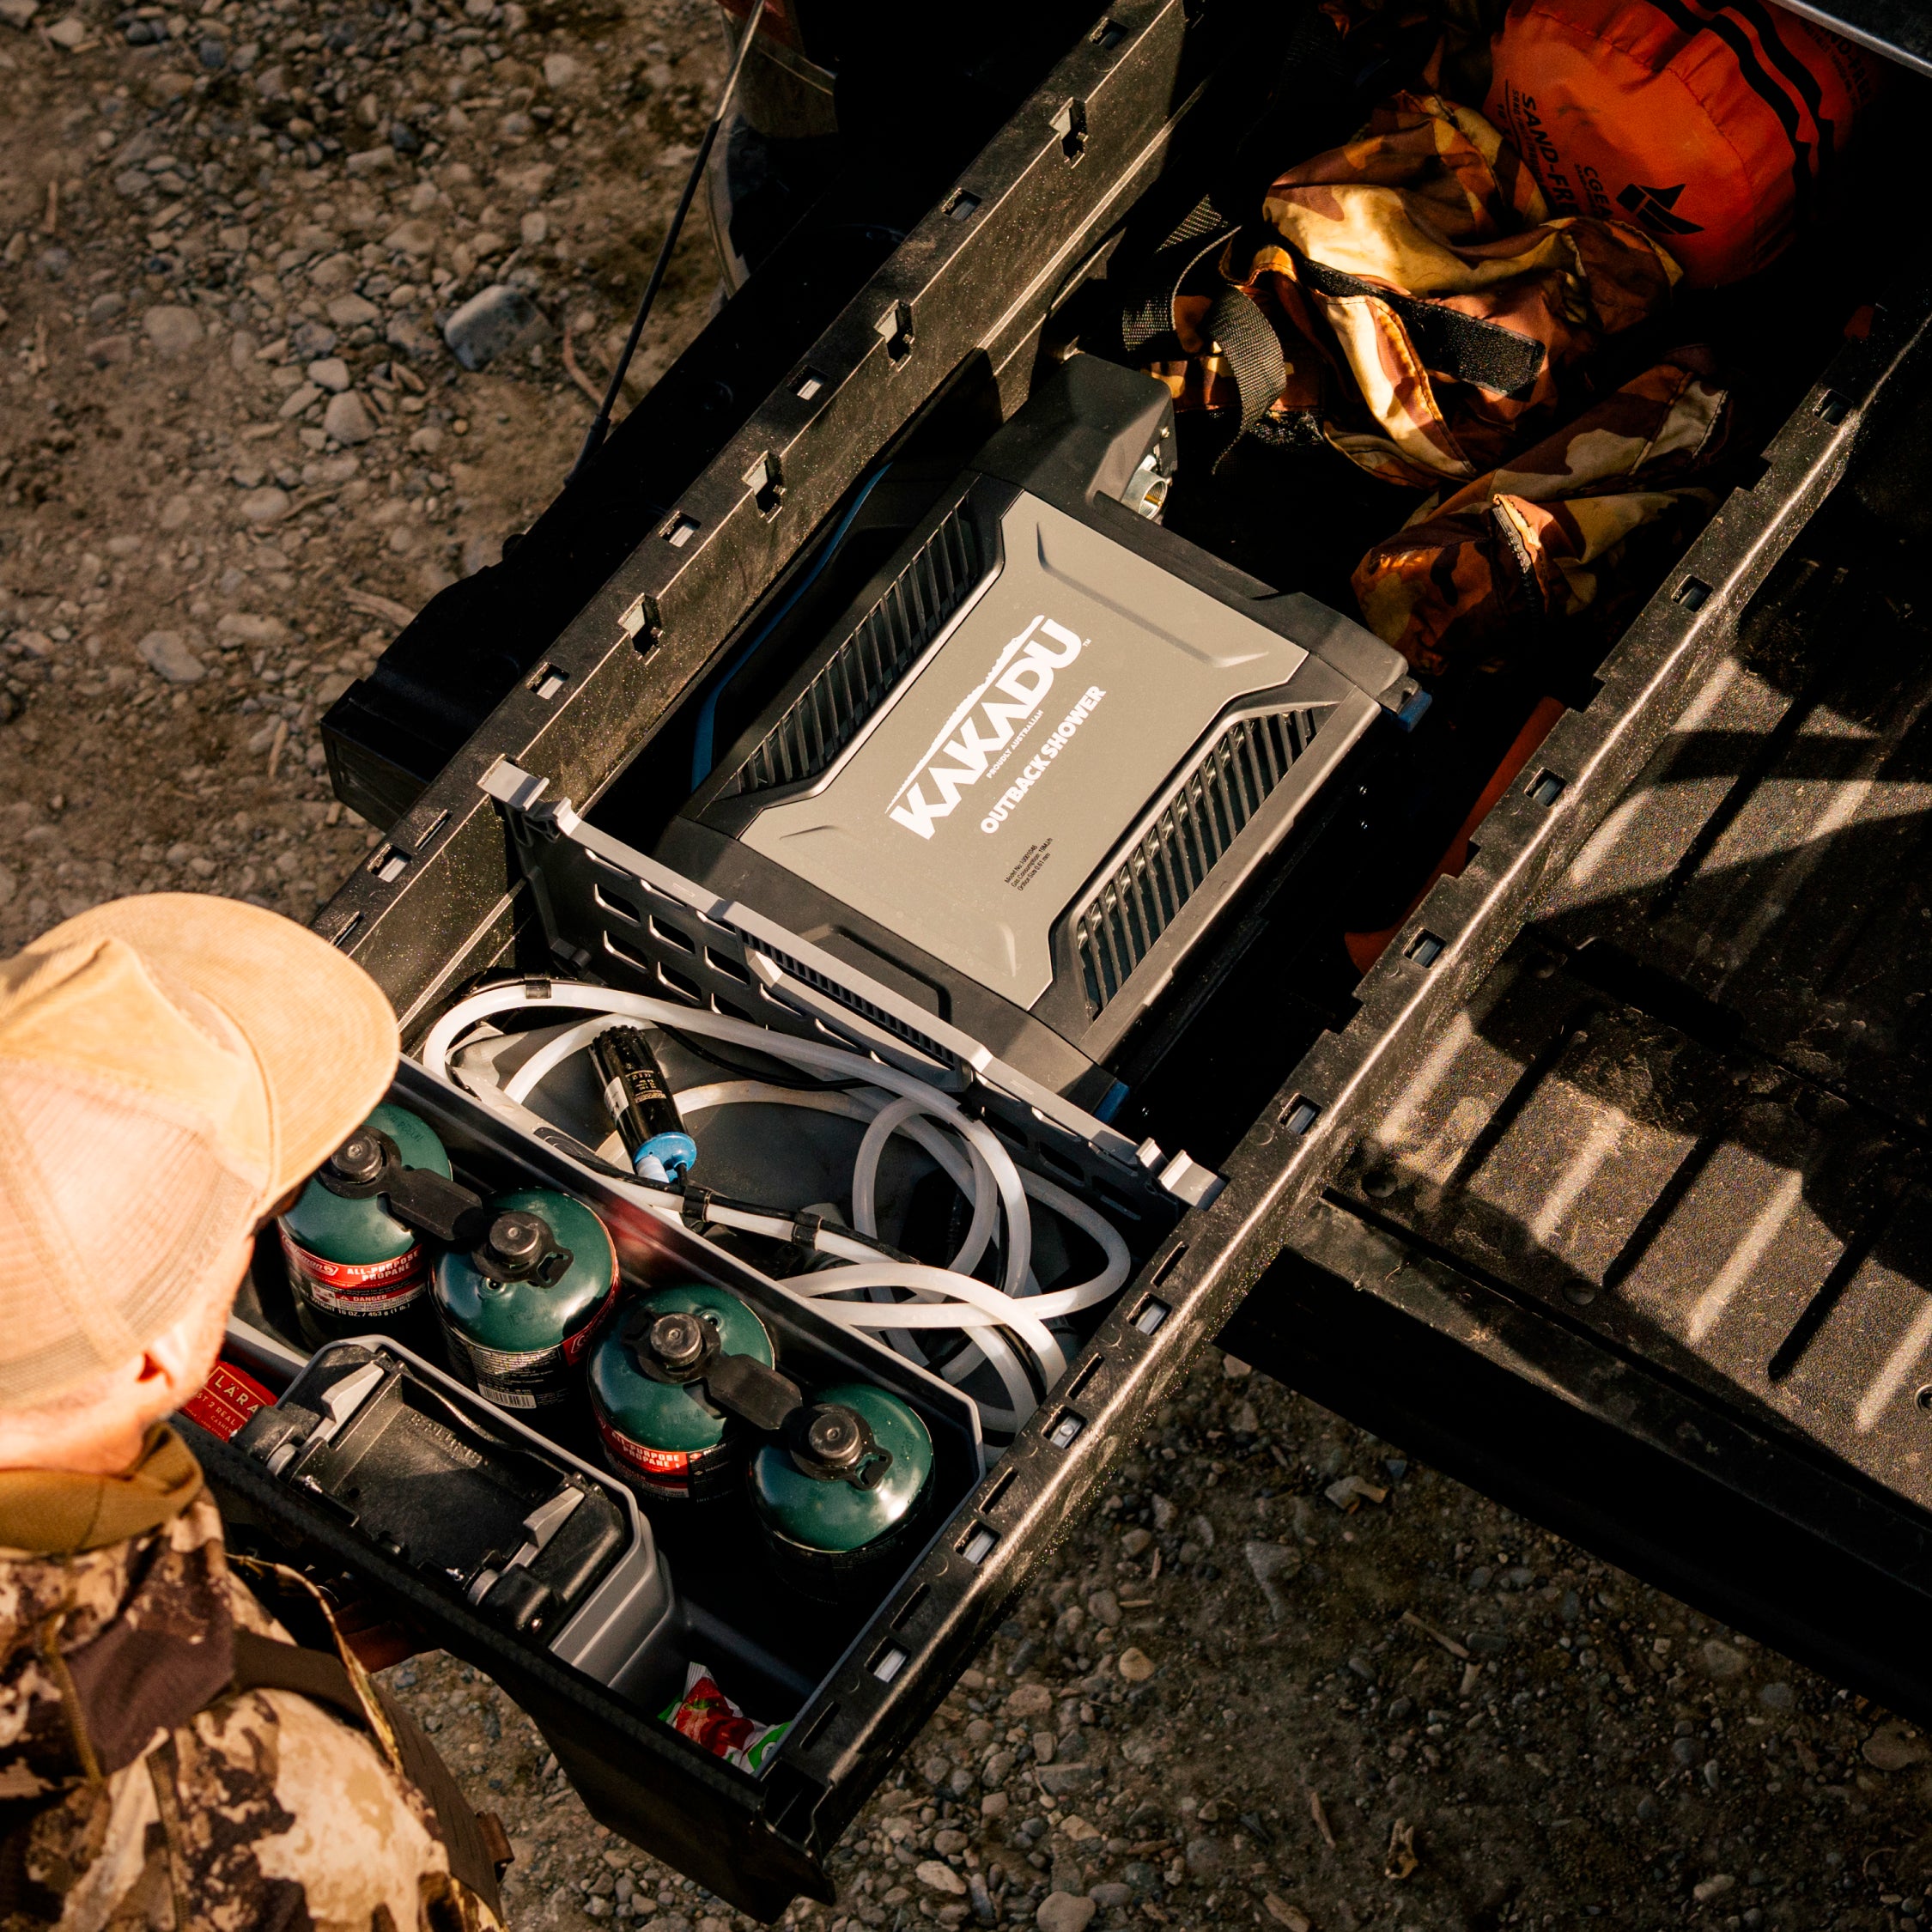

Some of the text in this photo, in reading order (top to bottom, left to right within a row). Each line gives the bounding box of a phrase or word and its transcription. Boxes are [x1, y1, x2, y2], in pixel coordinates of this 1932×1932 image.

[889, 617, 1083, 841] KAKADU
[986, 709, 1044, 780] PROUDLY AUSTRALIAN
[981, 685, 1107, 834] OUTBACK SHOWER
[347, 1249, 419, 1277] ALL-PURPOSE
[361, 1261, 411, 1281] PROPANE
[353, 1294, 388, 1303] DANGER
[215, 1406, 236, 1425] REAL
[611, 1431, 679, 1461] ALL-PURPOSE
[623, 1445, 670, 1467] PROPANE
